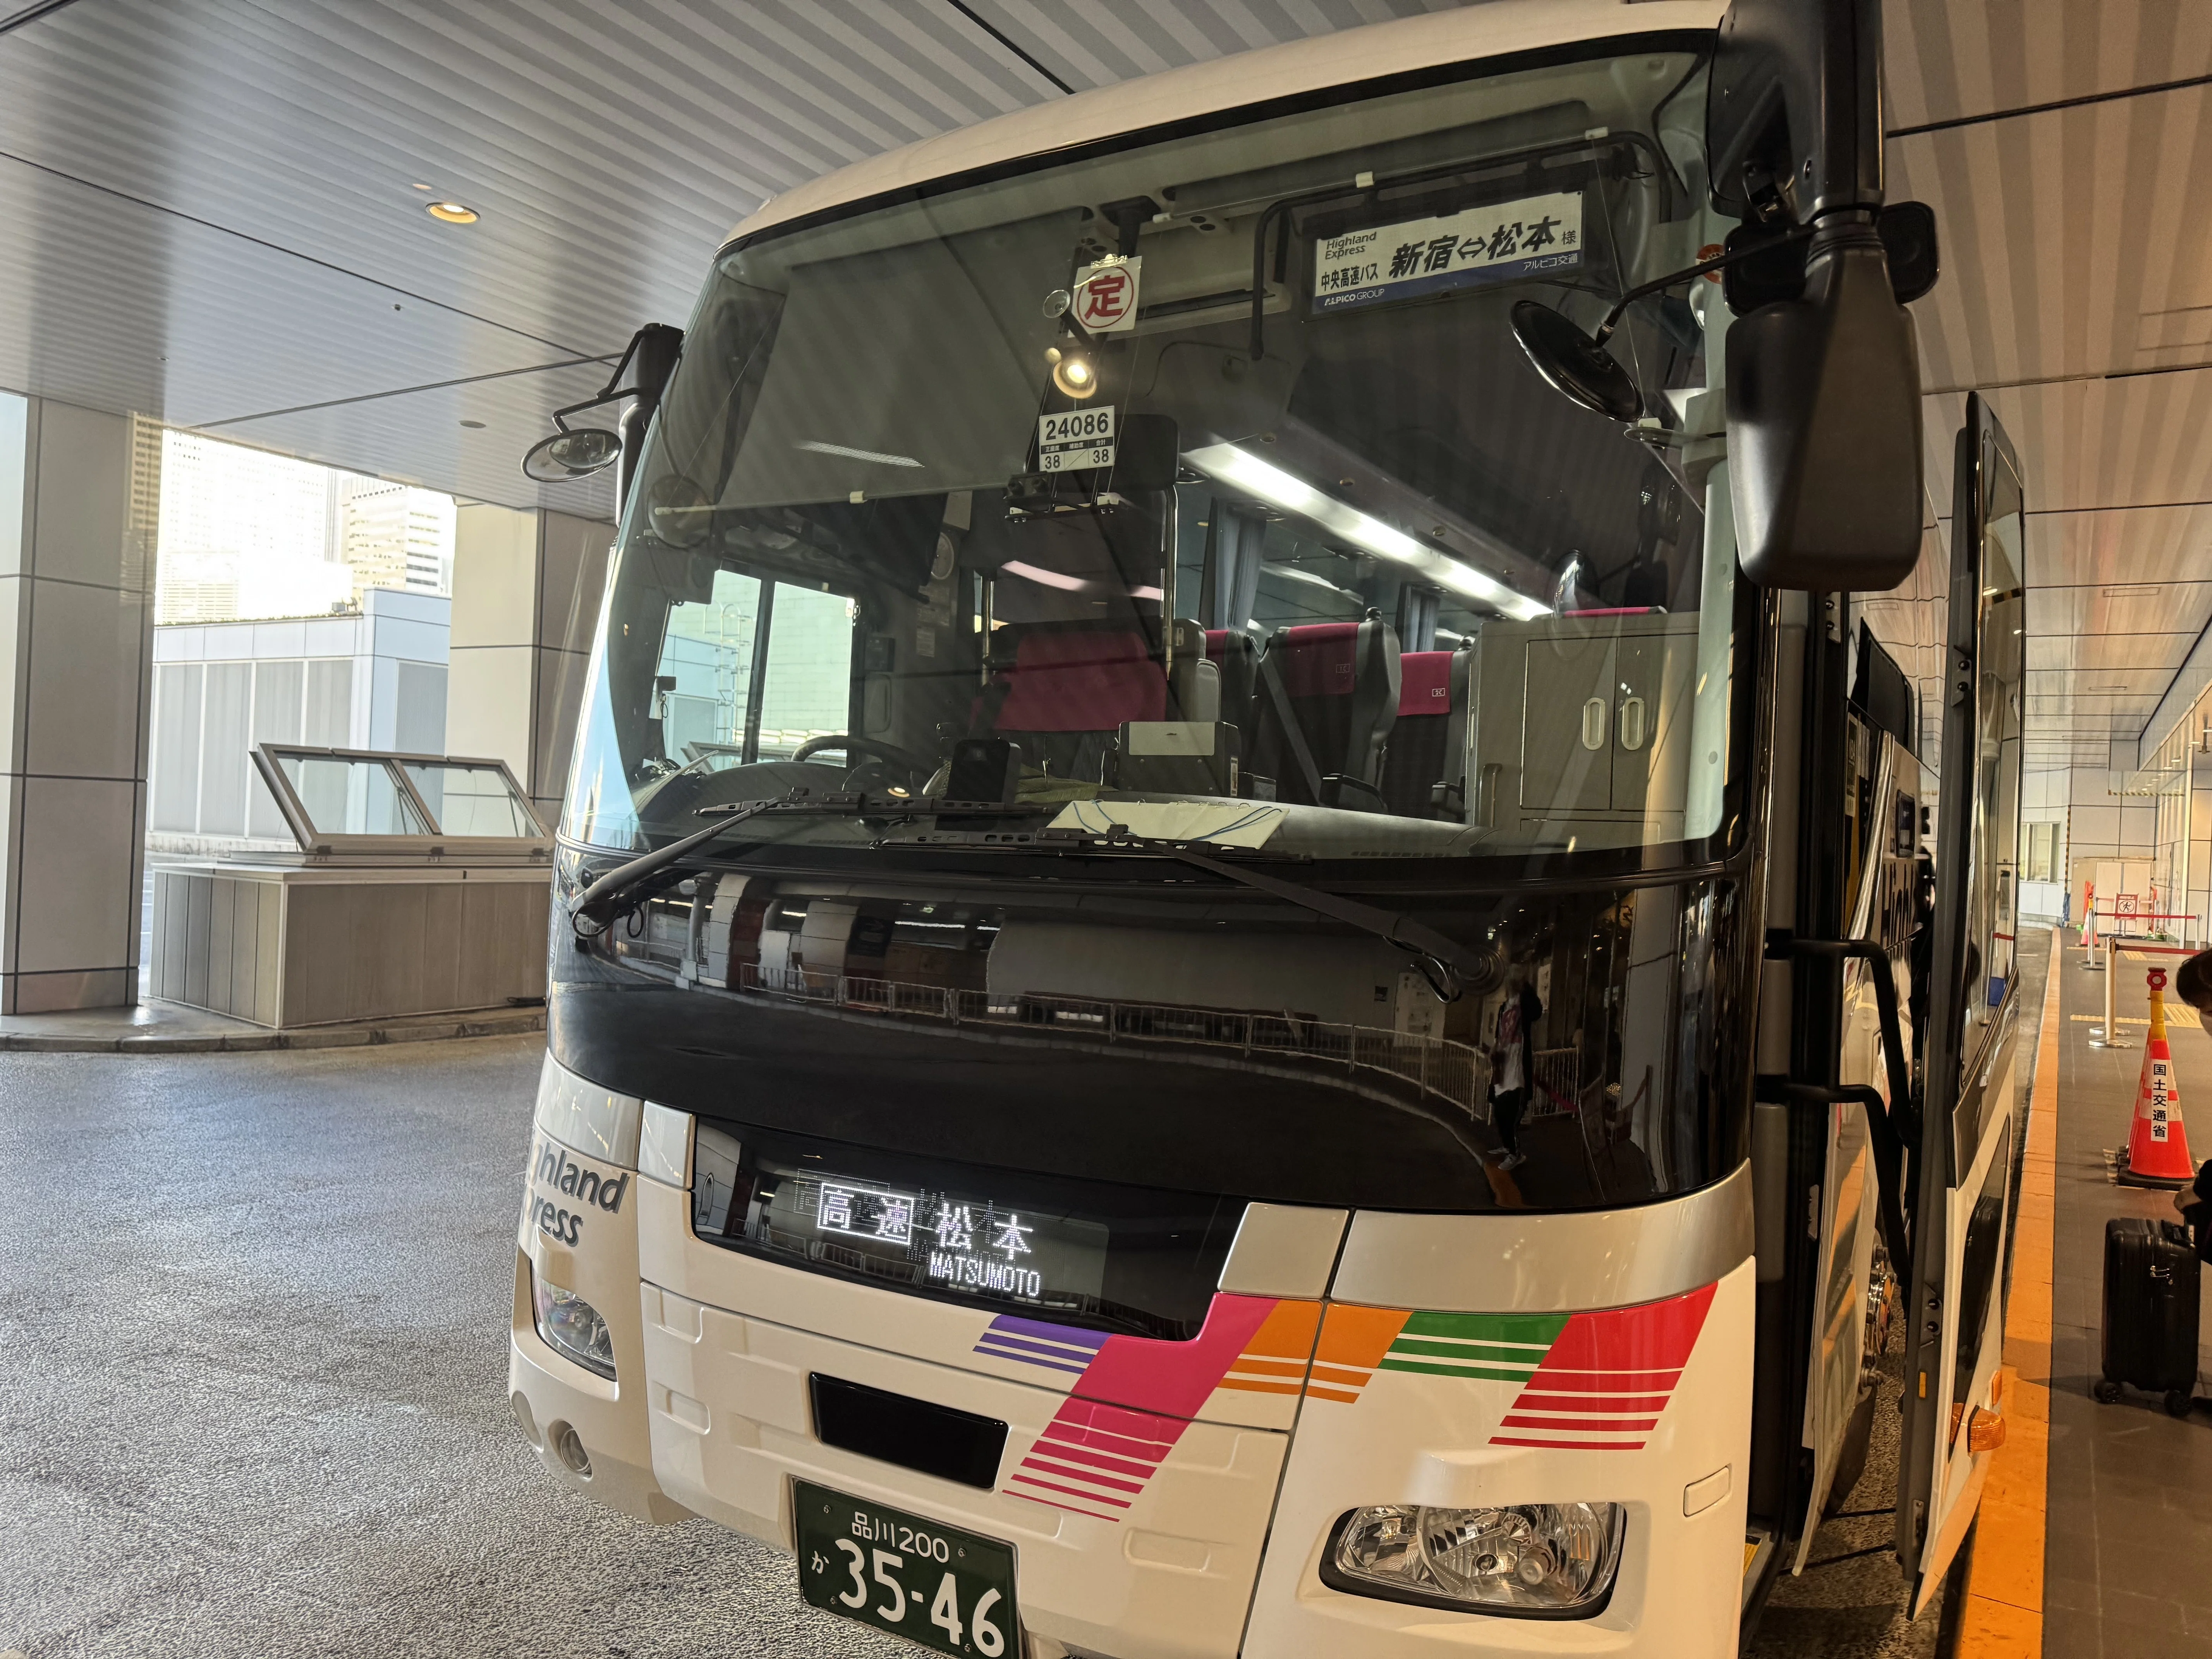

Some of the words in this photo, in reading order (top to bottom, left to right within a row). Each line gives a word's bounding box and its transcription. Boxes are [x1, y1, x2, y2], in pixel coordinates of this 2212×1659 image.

[1325, 245, 1366, 260] Express
[1327, 232, 1377, 250] Highland
[1389, 235, 1460, 278] 新宿
[1487, 216, 1562, 260] 松本
[1562, 230, 1577, 245] 様
[1085, 275, 1125, 320] 定
[1321, 263, 1378, 291] 中央高速バス
[1324, 294, 1356, 306] ALPICO
[1357, 289, 1384, 300] GROUP
[1046, 412, 1108, 440] 24086
[1045, 455, 1060, 469] 38
[1093, 449, 1109, 464] 38
[2153, 1064, 2167, 1137] 国土交通省
[538, 1142, 630, 1214] hland
[531, 1195, 584, 1248] ress
[823, 1190, 908, 1240] 高速
[934, 1202, 1034, 1261] 松本
[929, 1250, 1041, 1297] MATSUMOTO
[811, 1550, 830, 1574] か
[835, 1538, 1005, 1658] 35-46
